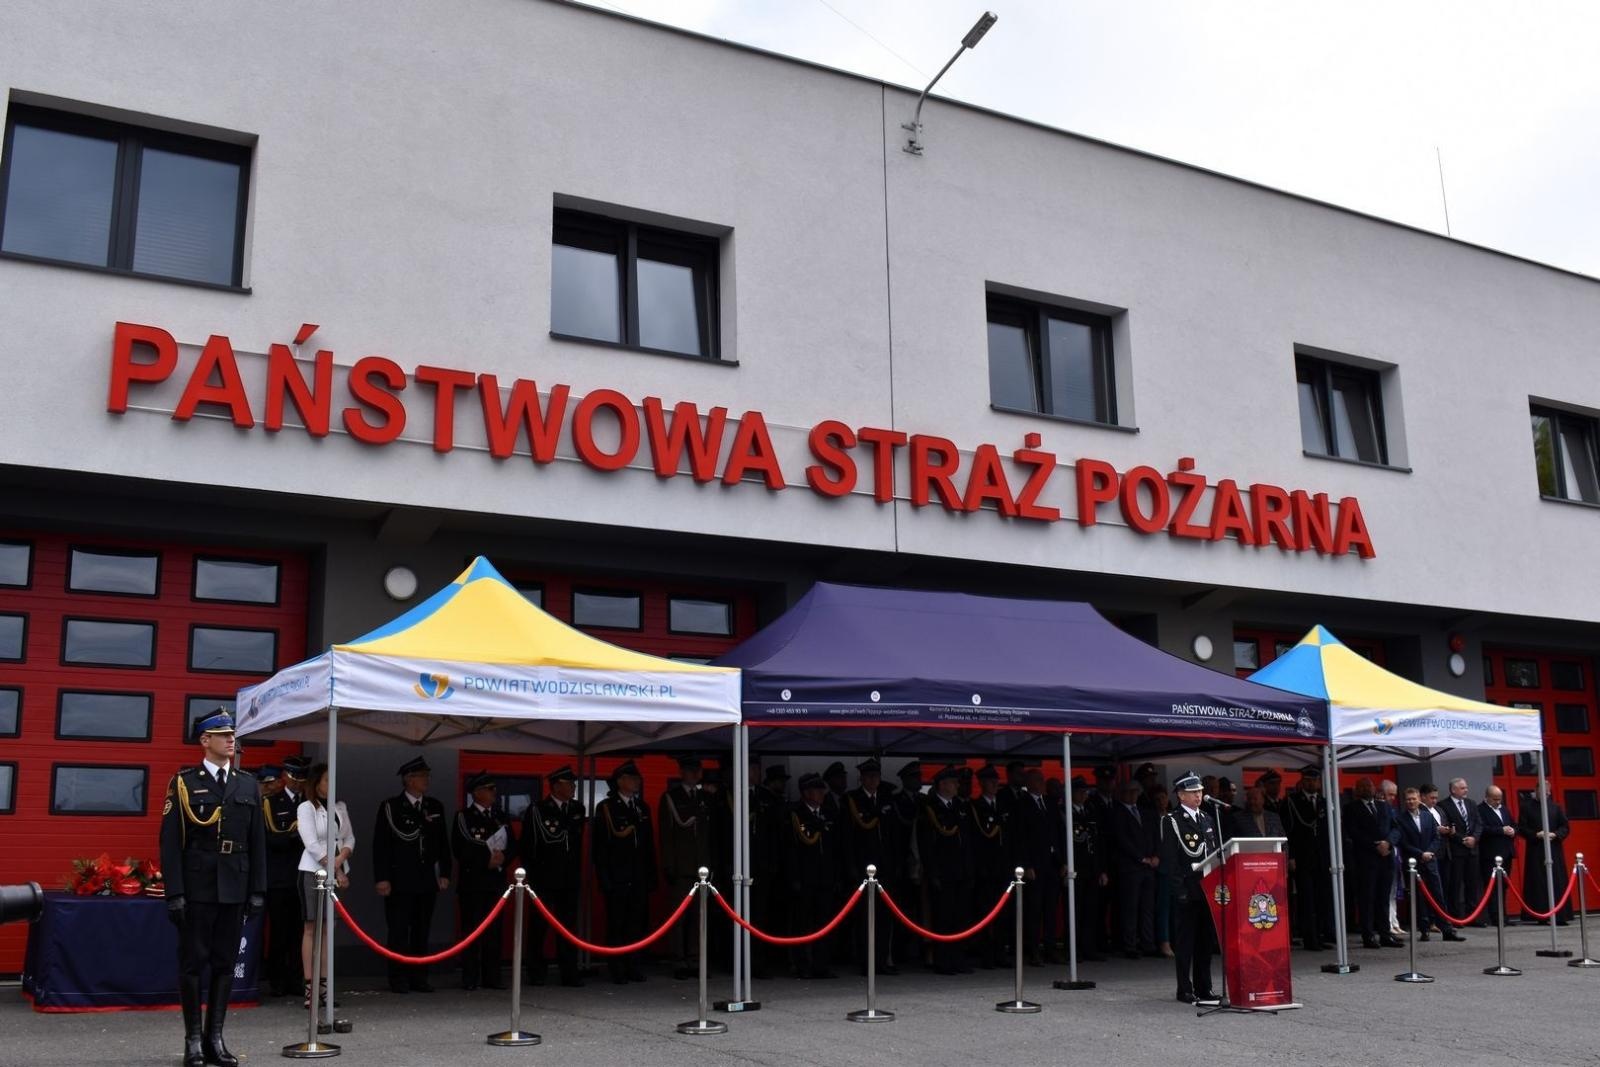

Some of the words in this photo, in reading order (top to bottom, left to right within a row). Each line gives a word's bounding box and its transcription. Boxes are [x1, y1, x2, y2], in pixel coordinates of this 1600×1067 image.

[107, 320, 784, 490] PAŃSTWOWA
[806, 420, 1060, 522] STRAŻ
[1077, 457, 1376, 558] POŻARNA
[1171, 702, 1228, 716] PAŃSTWOWA
[1229, 707, 1255, 719] STRAŻ
[1257, 709, 1296, 722] POŻARNA
